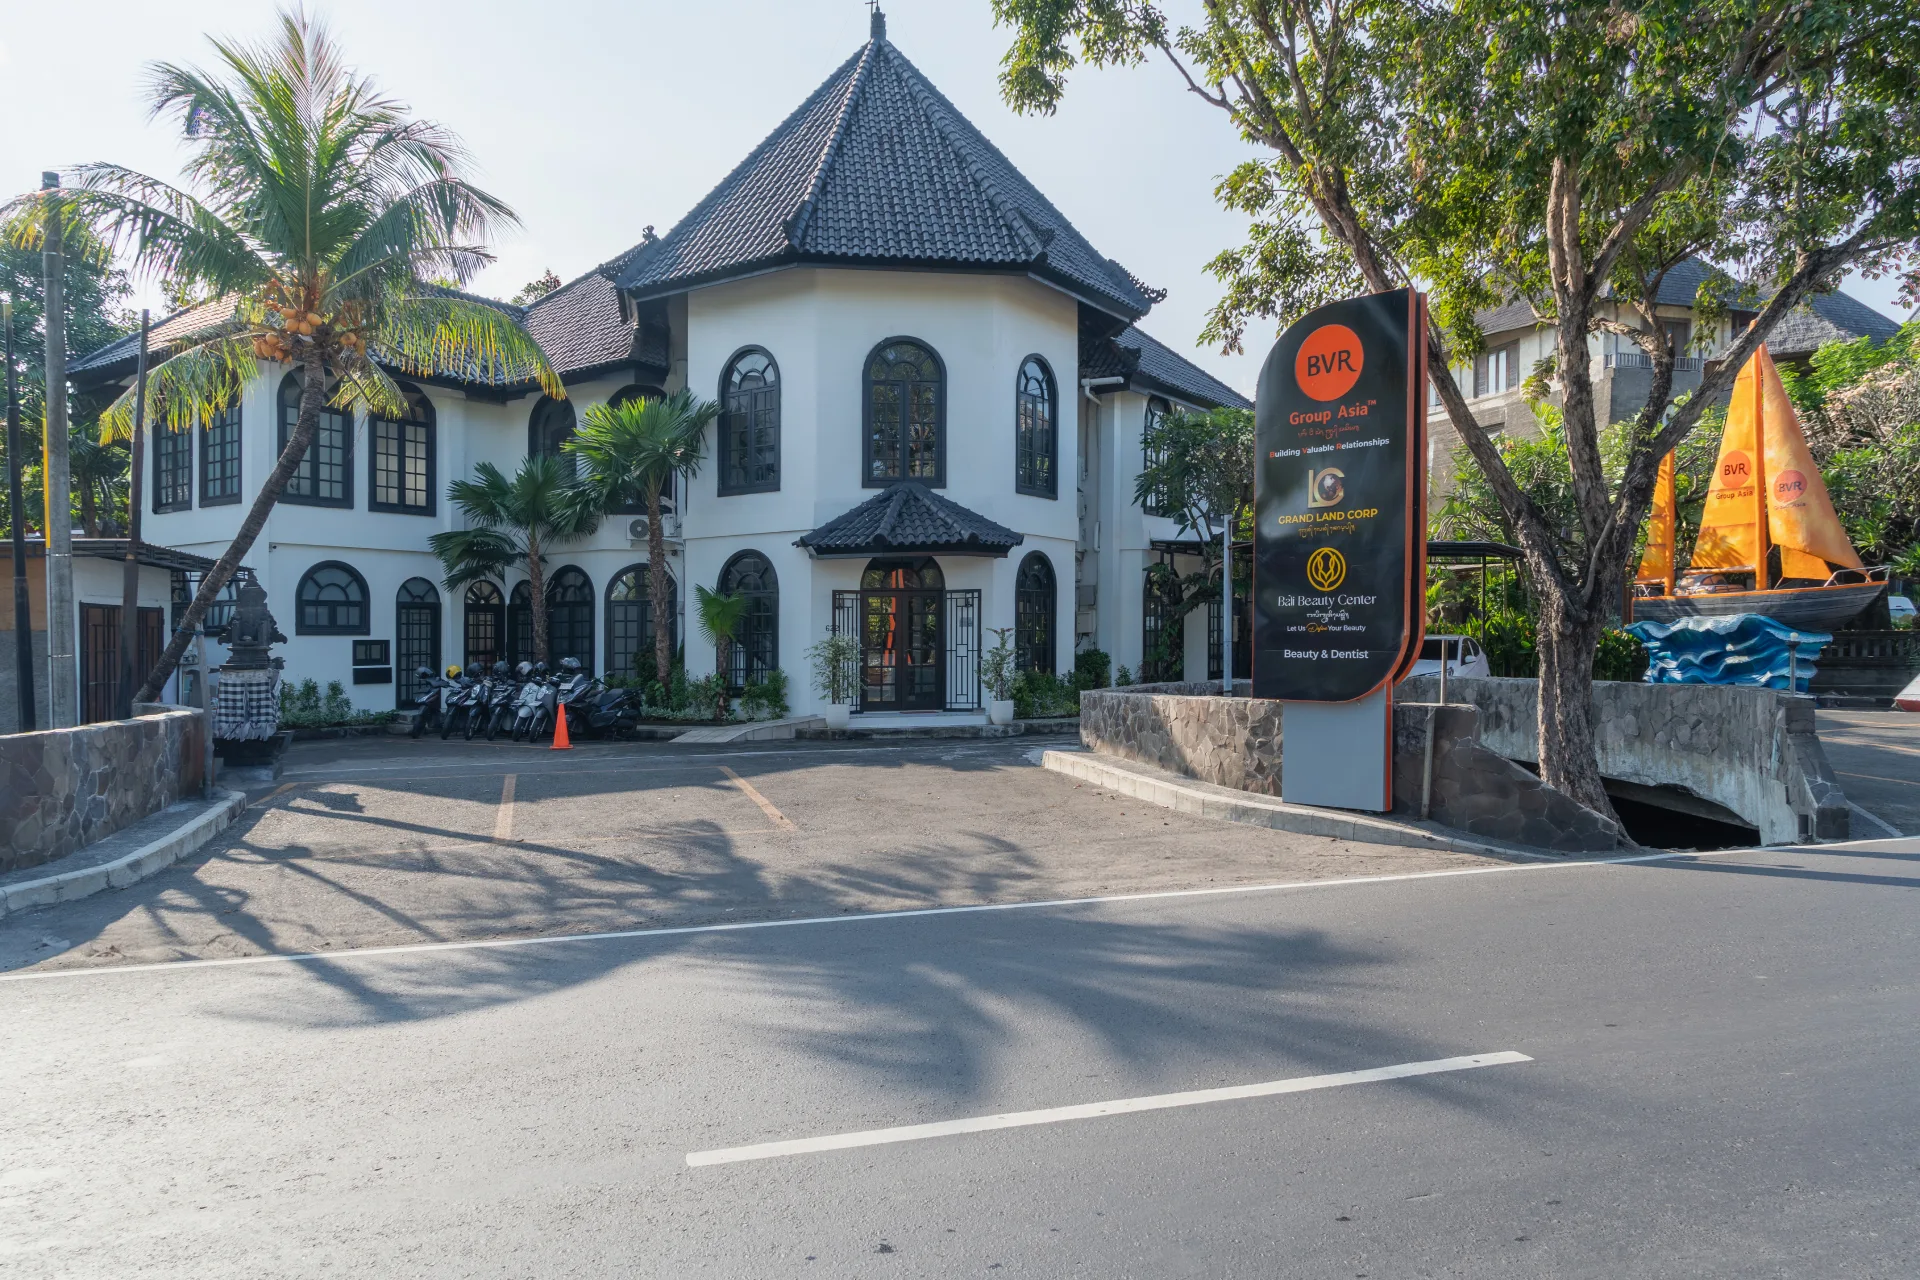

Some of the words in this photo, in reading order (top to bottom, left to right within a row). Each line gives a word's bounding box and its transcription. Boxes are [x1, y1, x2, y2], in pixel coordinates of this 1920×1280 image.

[1307, 350, 1357, 377] BVR
[1289, 411, 1332, 425] Group
[1269, 448, 1300, 458] Building
[1302, 444, 1335, 454] Valuable
[1336, 437, 1390, 450] Relationships
[1724, 463, 1748, 476] BVR
[1778, 481, 1803, 493] BVR
[1716, 492, 1735, 500] Group
[1278, 513, 1314, 525] GRAND
[1316, 511, 1345, 522] LAND
[1347, 508, 1379, 519] CORP
[1297, 595, 1335, 609] Beauty
[1337, 594, 1377, 606] Center
[1343, 624, 1366, 632] Beauty
[1284, 649, 1319, 661] Beauty
[1320, 650, 1329, 659] &
[1330, 649, 1369, 659] Dentist
